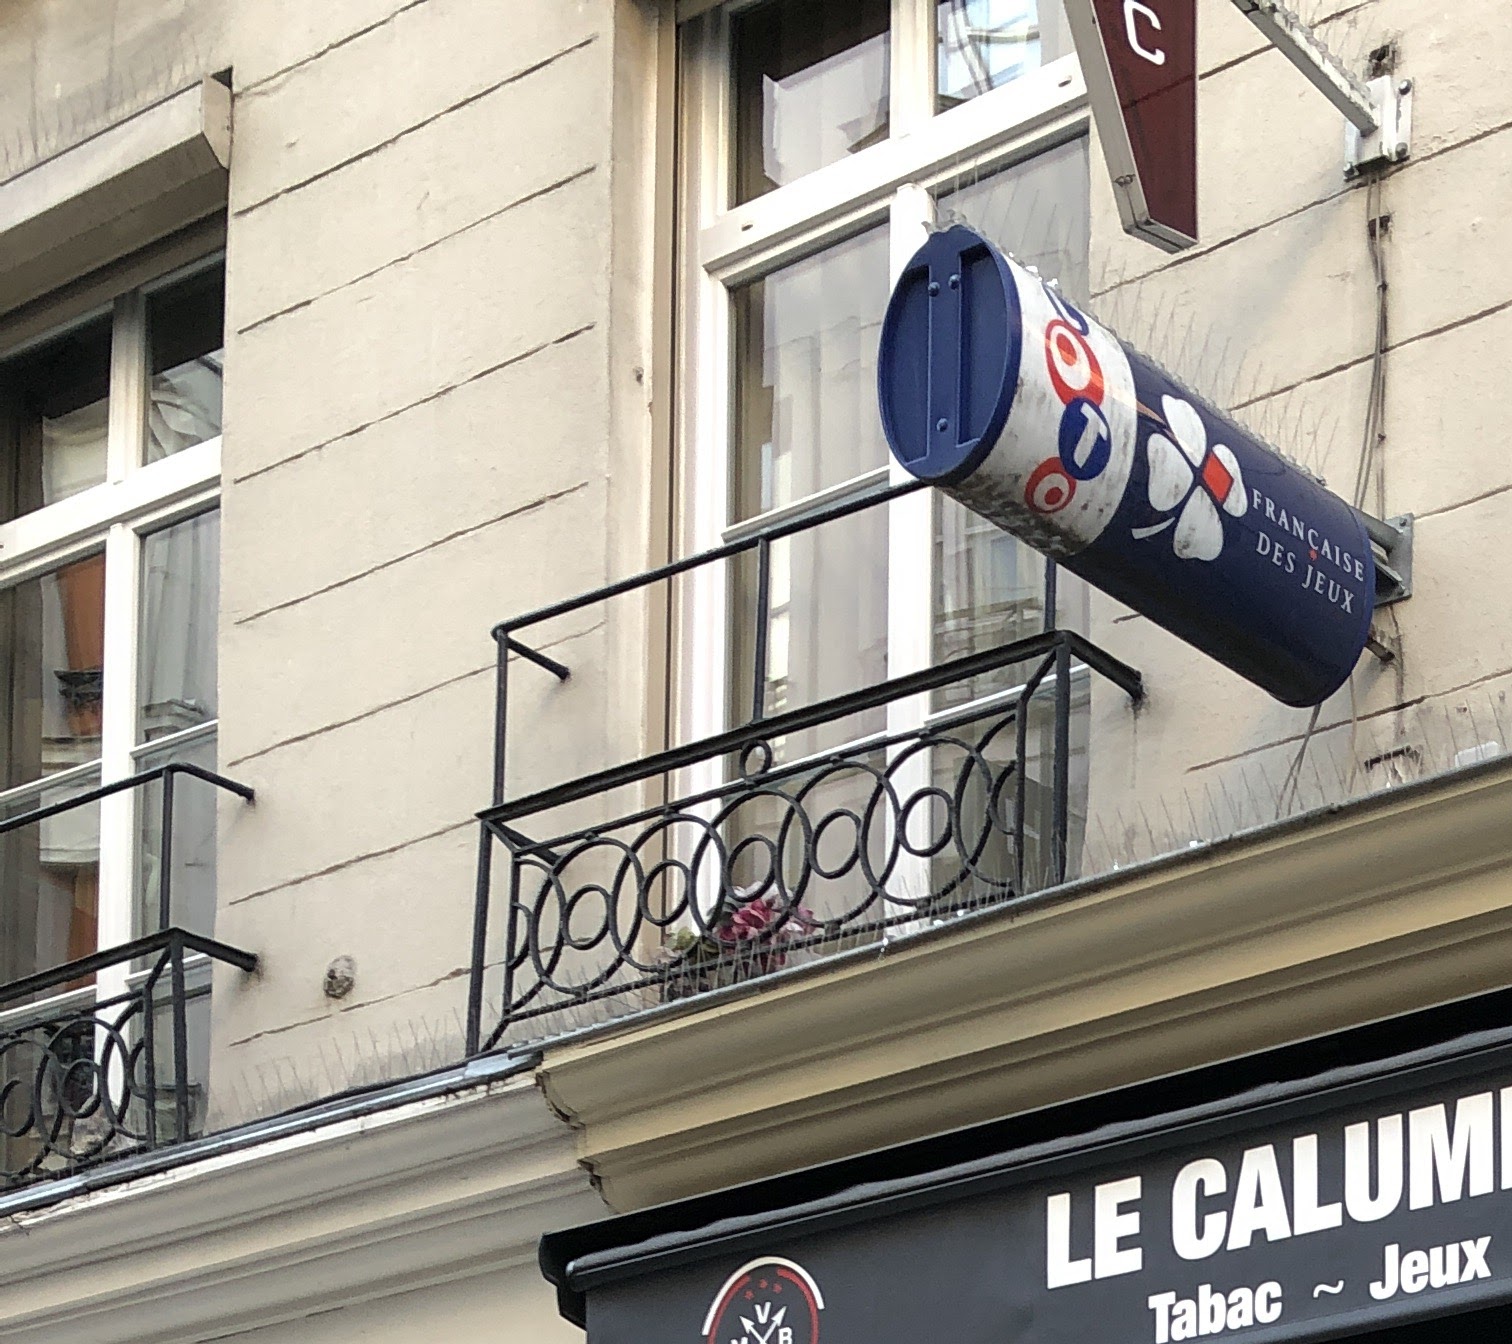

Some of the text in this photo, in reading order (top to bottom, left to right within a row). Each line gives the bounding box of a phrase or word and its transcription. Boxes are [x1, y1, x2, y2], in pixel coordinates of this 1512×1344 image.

[1252, 488, 1365, 582] FRANÇAISE
[1255, 530, 1355, 614] DES JEUX
[1046, 1175, 1143, 1290] LE
[1368, 1235, 1492, 1302] Jeux
